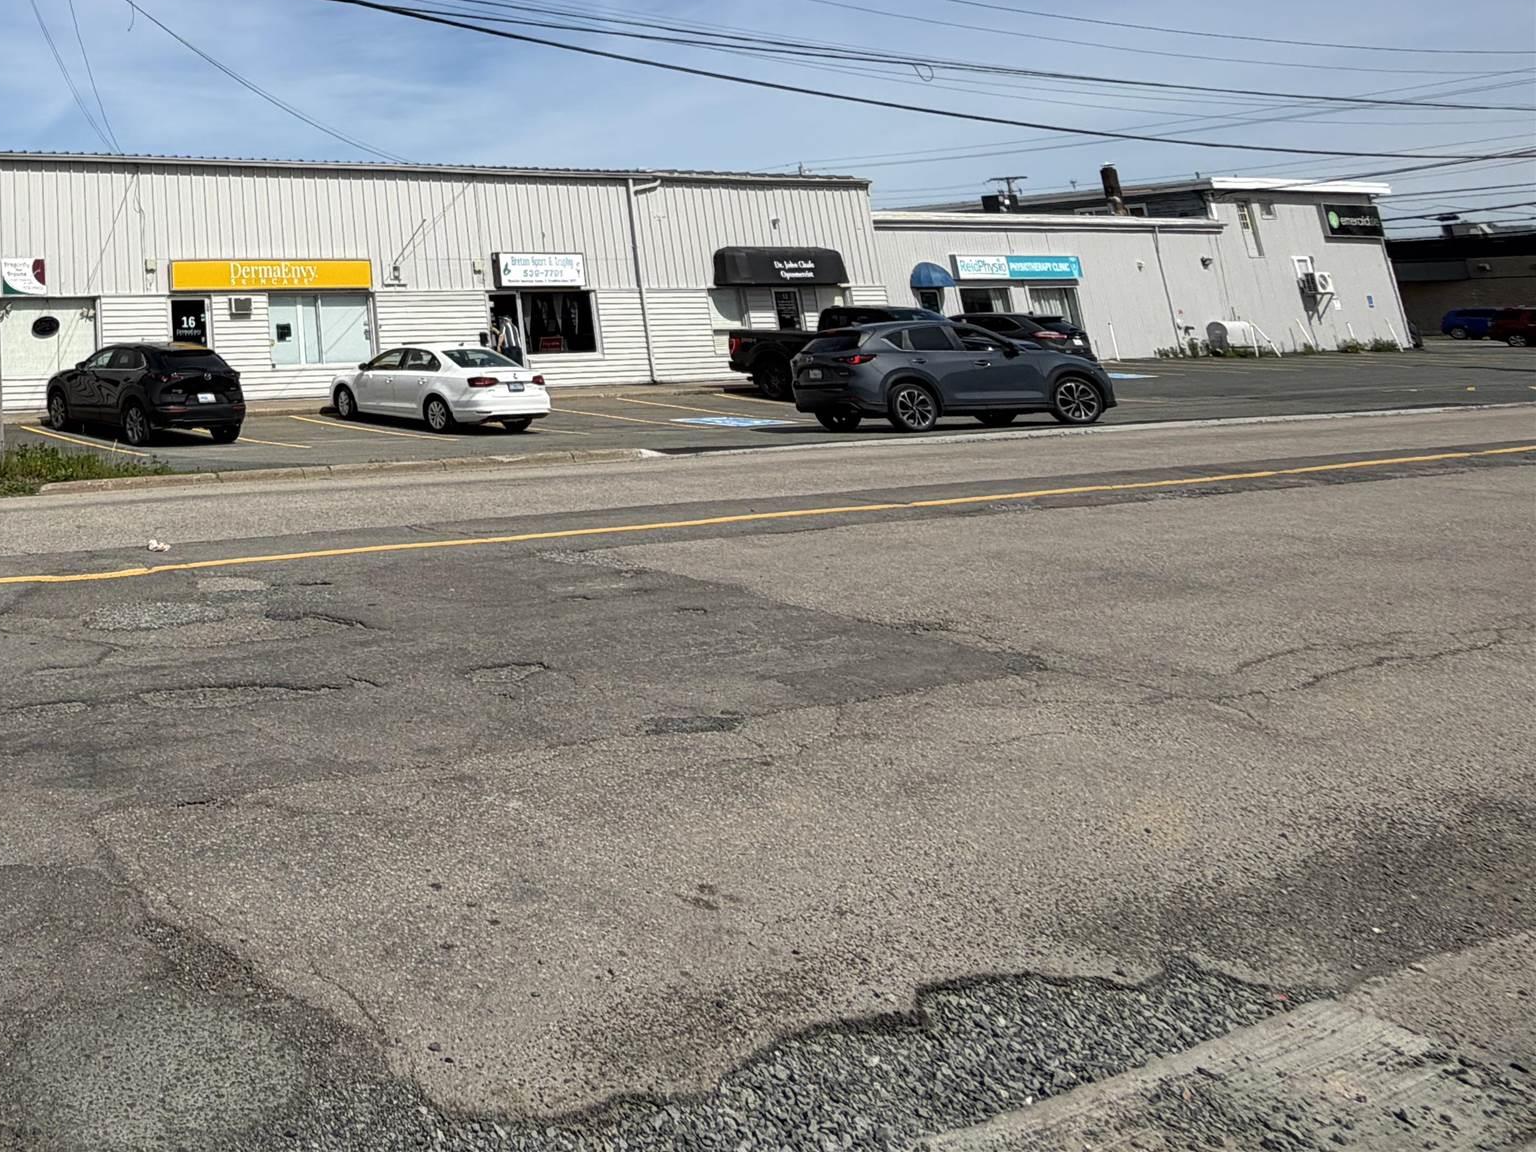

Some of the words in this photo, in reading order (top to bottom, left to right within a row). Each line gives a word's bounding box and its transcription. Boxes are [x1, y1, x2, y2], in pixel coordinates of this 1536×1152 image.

[959, 258, 1007, 273] ReidPhysio
[1053, 262, 1071, 272] CLINIC
[231, 278, 308, 286] SKINCARE
[181, 315, 196, 328] 16
